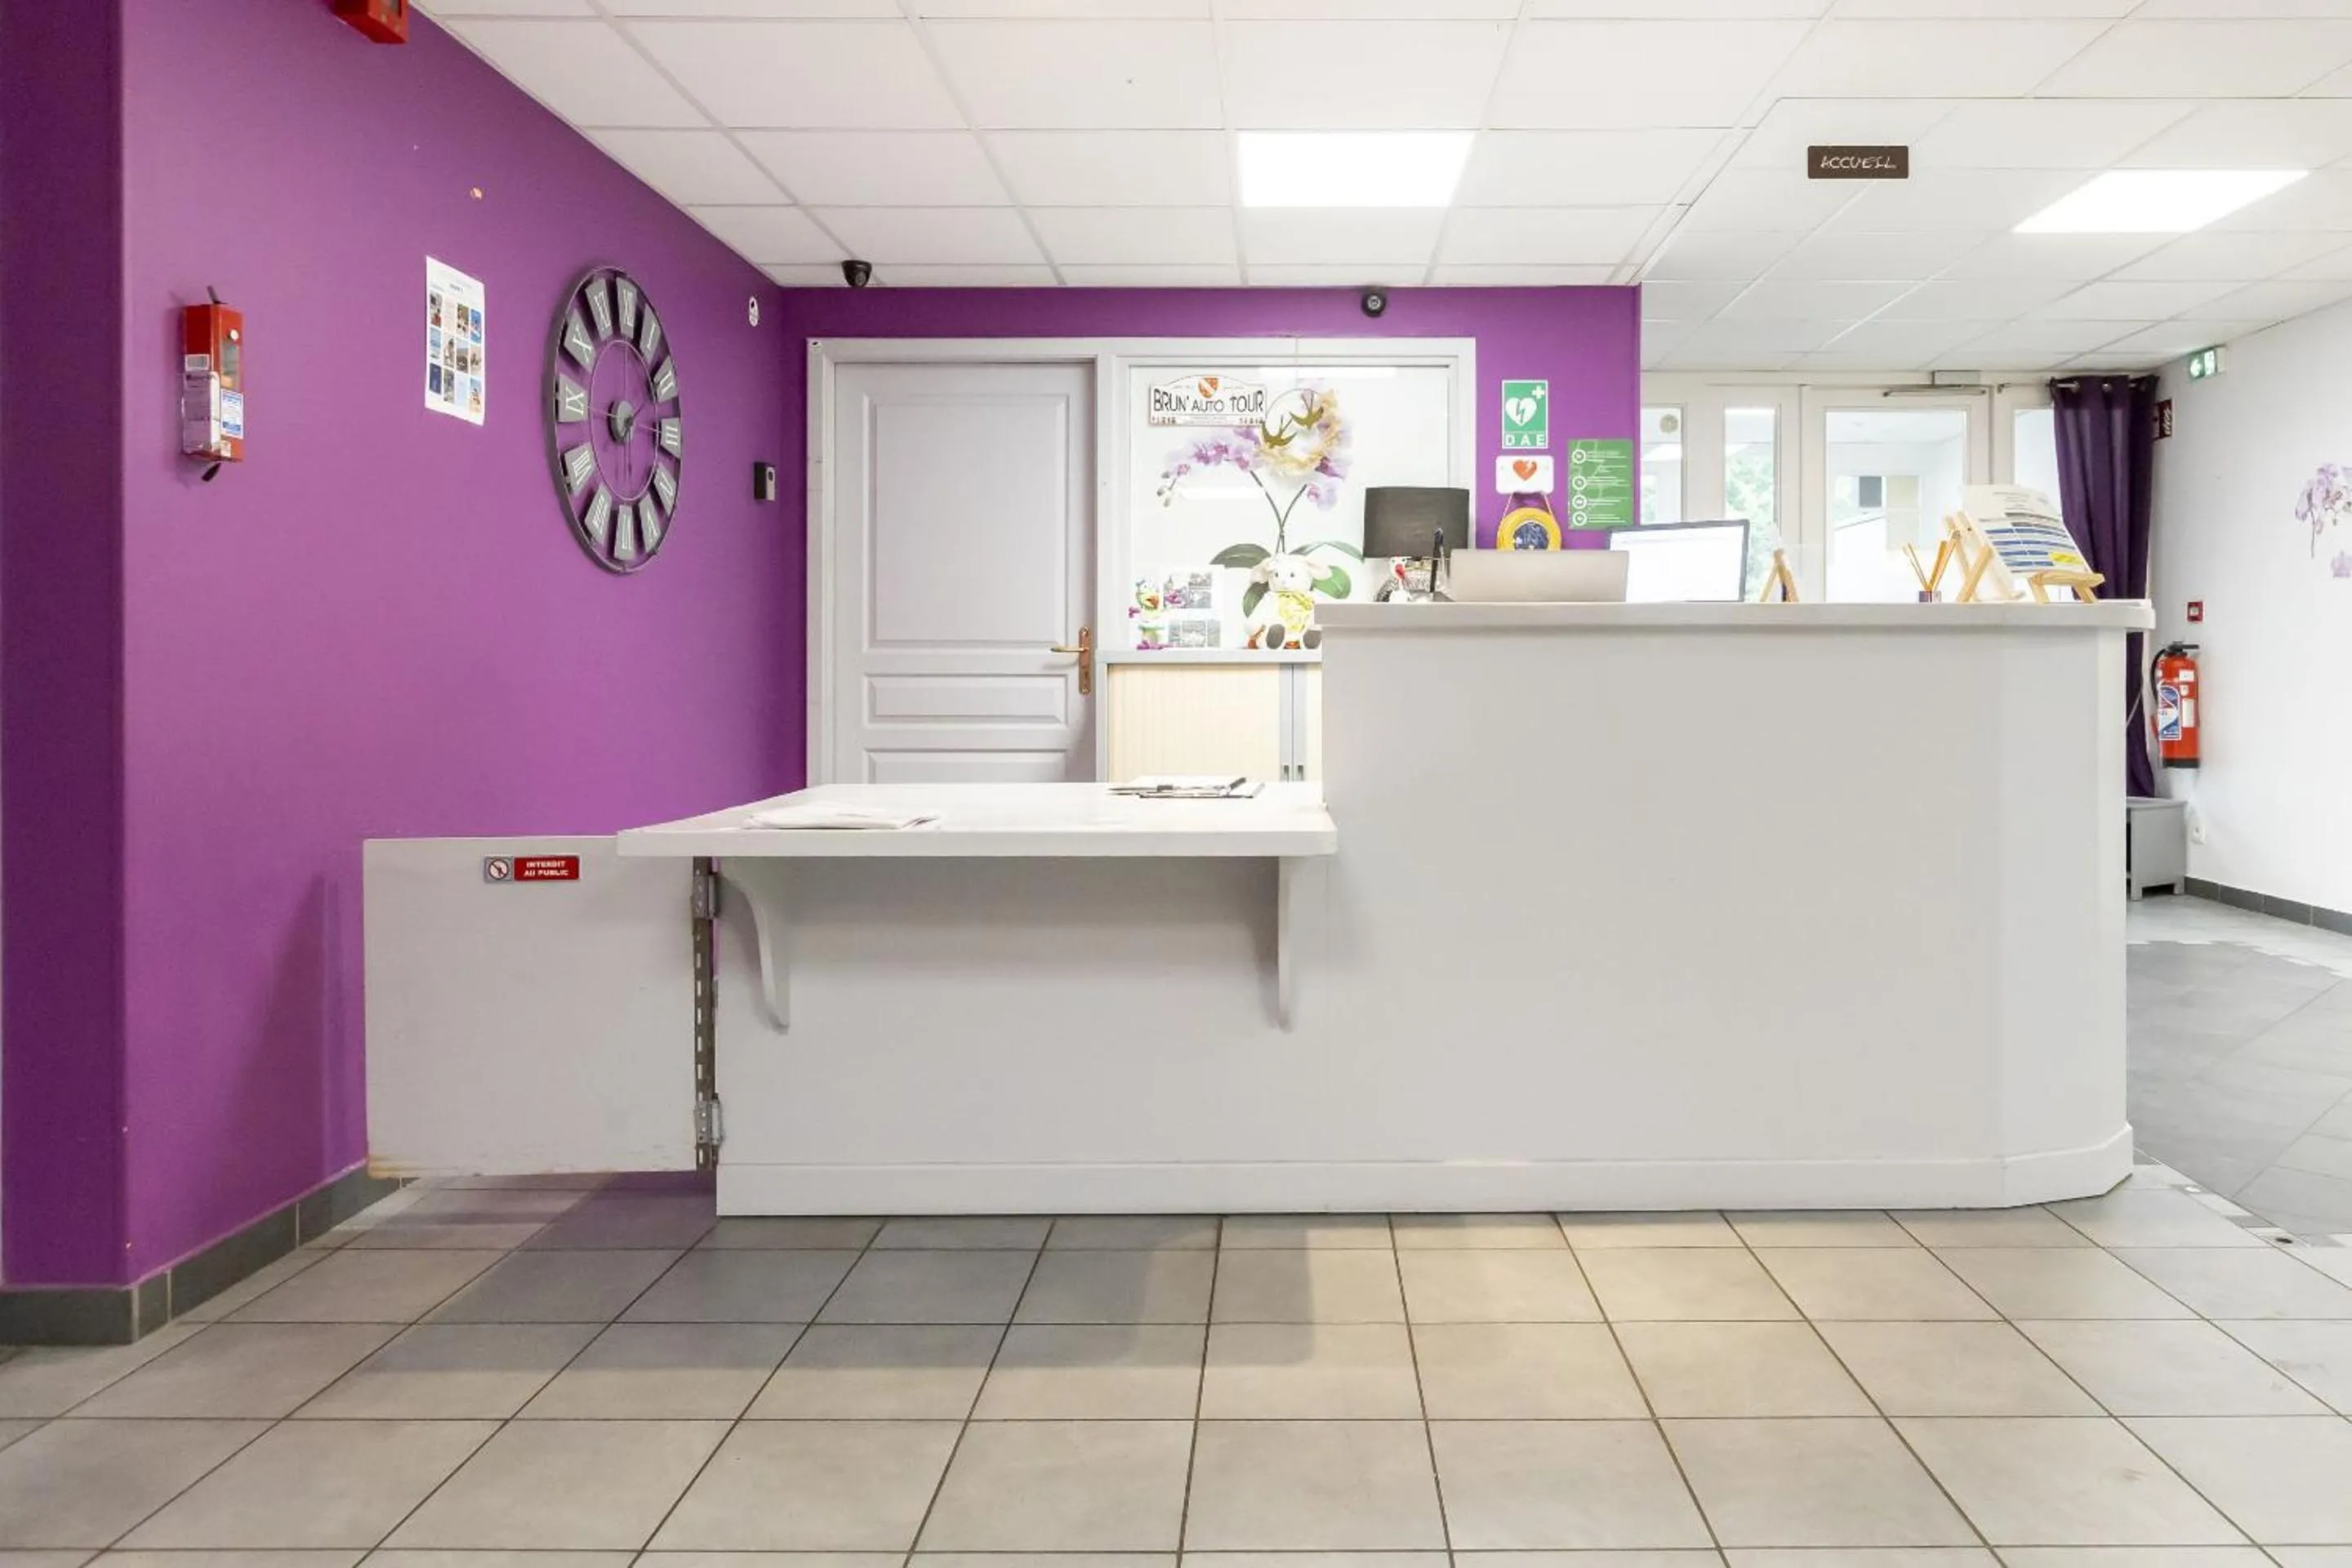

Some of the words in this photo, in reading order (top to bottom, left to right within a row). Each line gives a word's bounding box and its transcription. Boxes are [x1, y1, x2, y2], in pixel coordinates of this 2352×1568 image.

[1820, 154, 1897, 169] ACCUEIL
[1153, 388, 1189, 412] BRUN'
[1191, 399, 1225, 412] AUTO
[1229, 389, 1264, 413] TOUR
[526, 860, 567, 868] INTERDIT
[537, 869, 569, 877] PUBLIC
